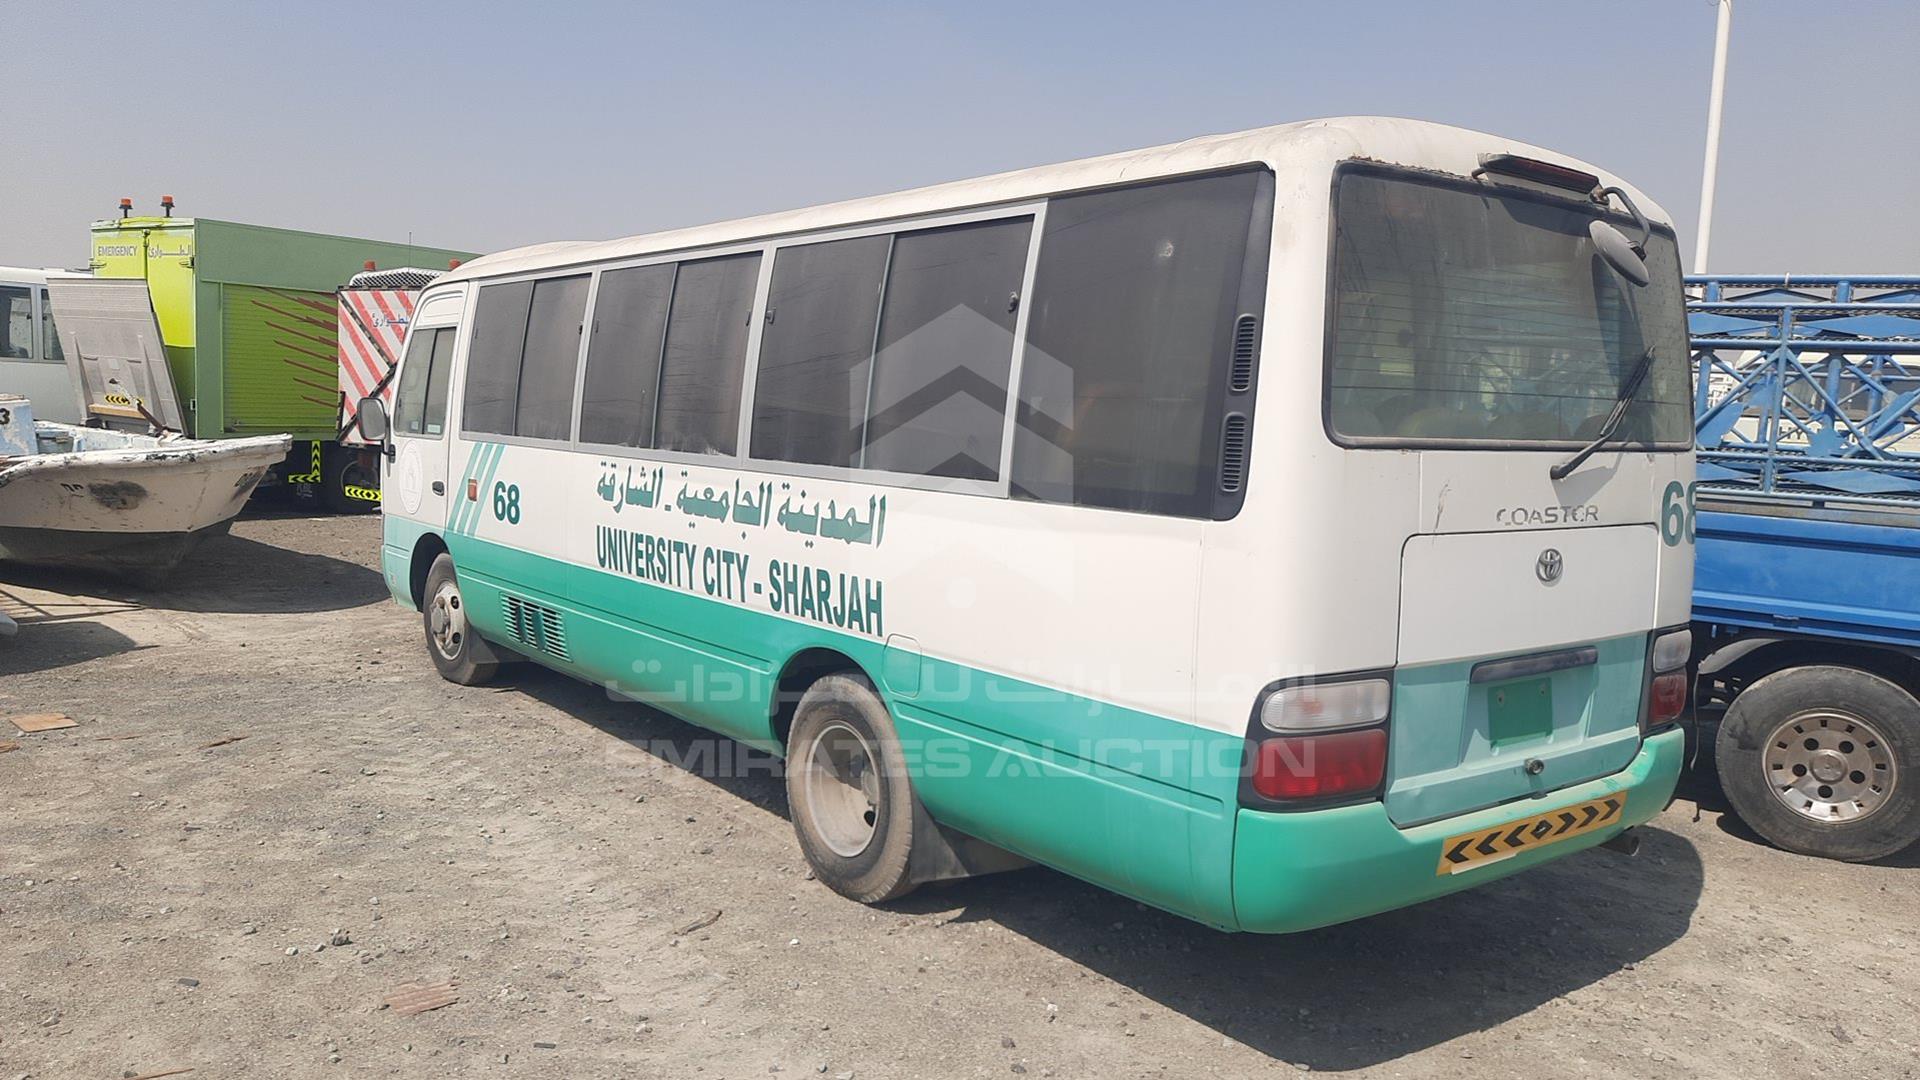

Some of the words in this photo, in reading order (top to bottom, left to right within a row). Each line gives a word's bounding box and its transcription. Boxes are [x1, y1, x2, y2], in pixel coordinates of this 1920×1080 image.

[97, 245, 138, 257] EMERGENCY
[493, 480, 520, 525] 68
[596, 461, 663, 514] الشارقة
[676, 470, 773, 540] الجامعية
[777, 481, 887, 549] المدينة
[1496, 504, 1600, 526] COASTER
[596, 524, 697, 590] UNIVERSITY
[702, 546, 750, 603] CITY
[768, 559, 884, 637] SHARJAH
